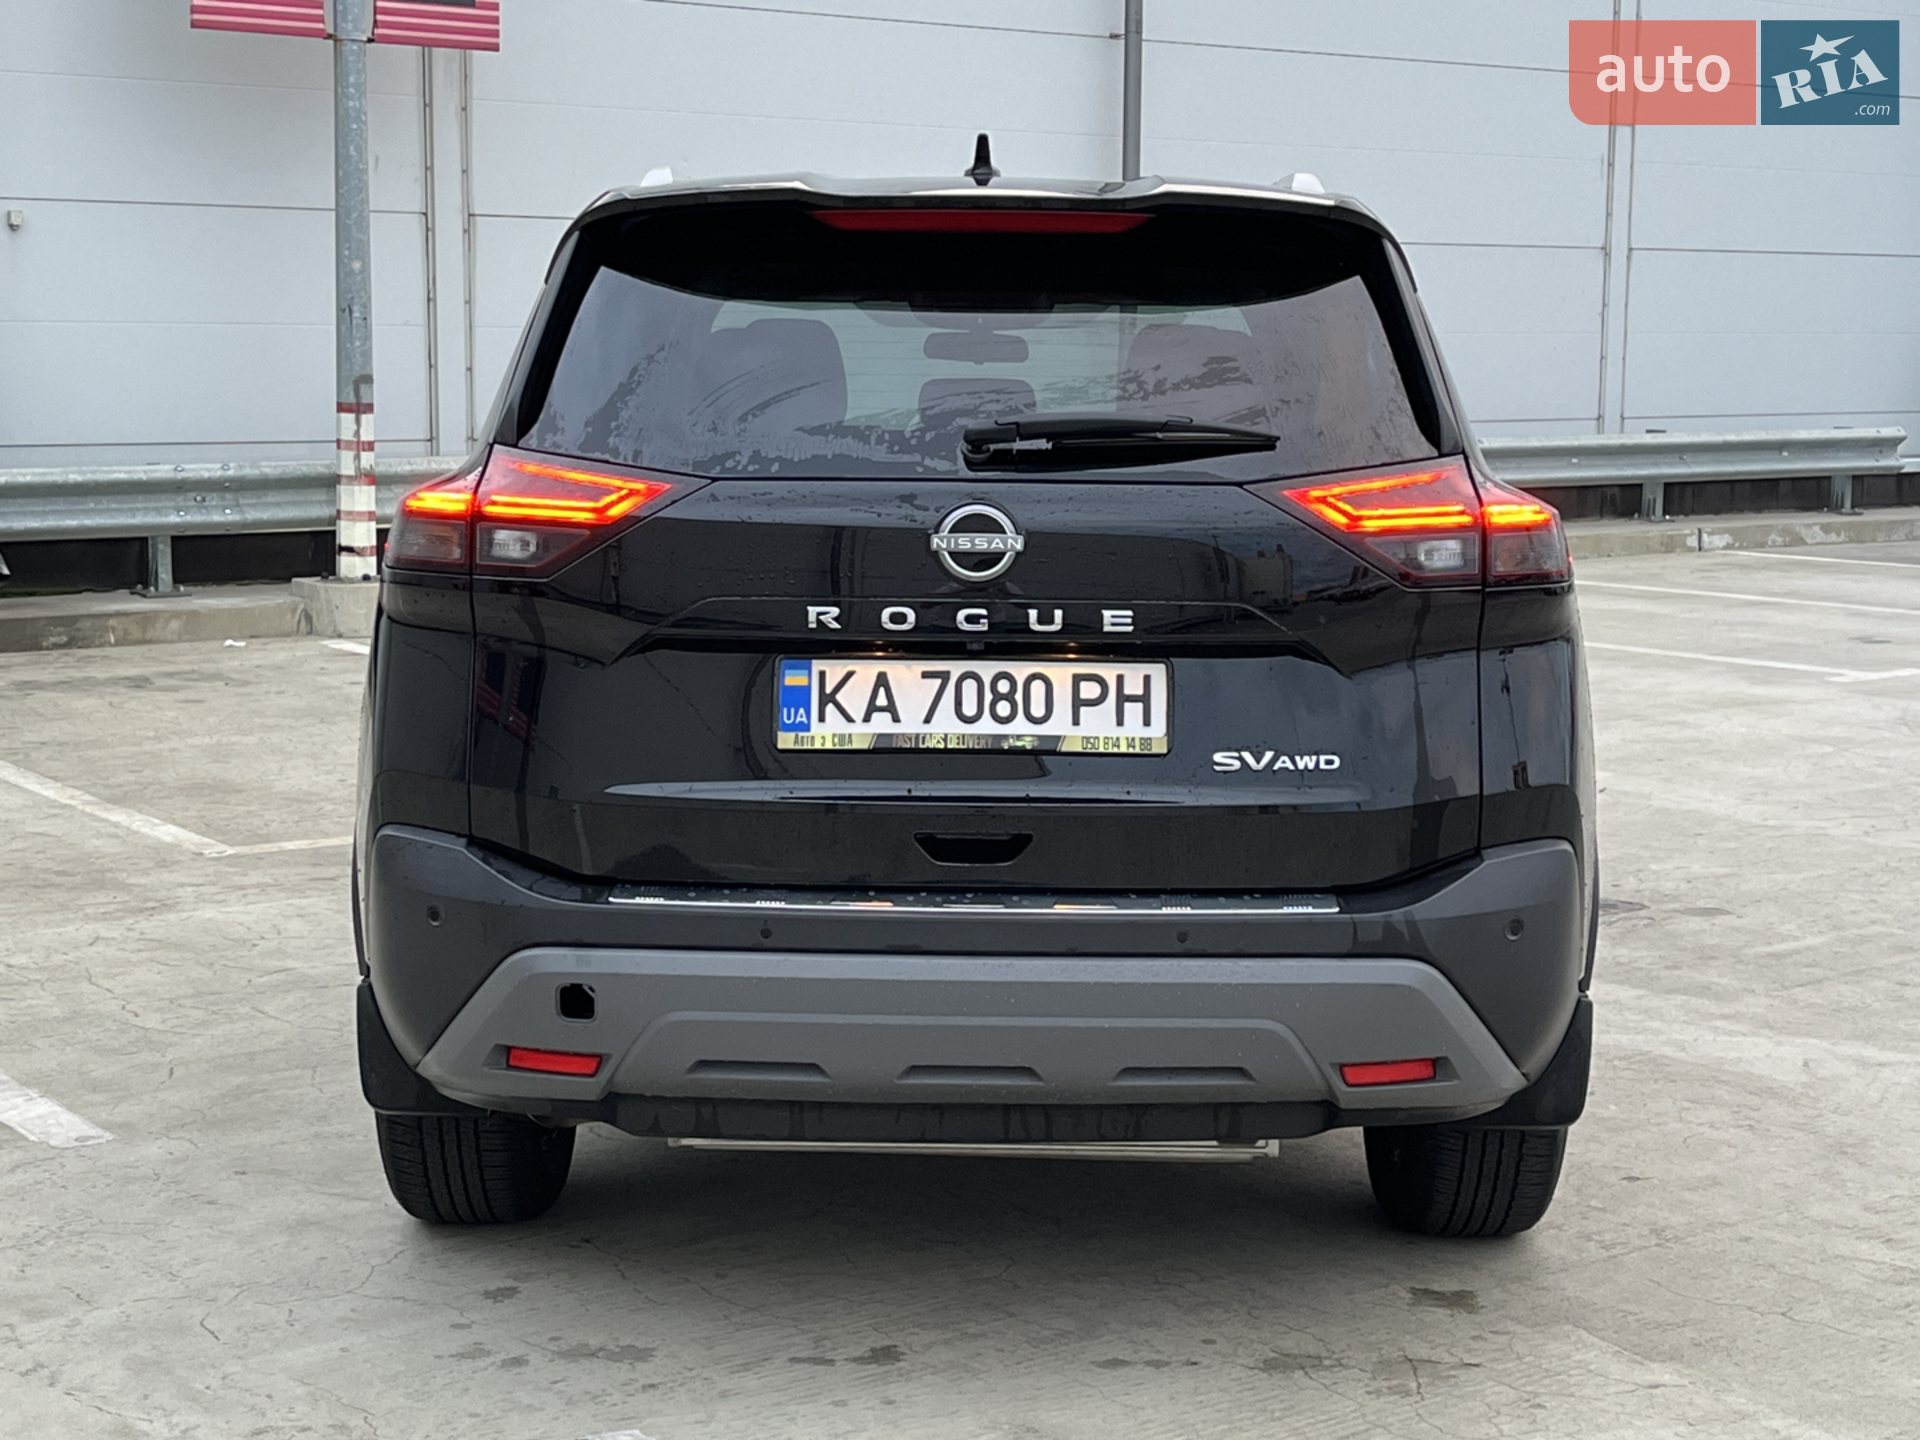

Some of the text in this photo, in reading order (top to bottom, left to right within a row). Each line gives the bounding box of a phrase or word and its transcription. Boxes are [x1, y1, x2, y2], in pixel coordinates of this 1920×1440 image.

[933, 537, 1022, 549] NISSAN
[807, 606, 1134, 632] ROGUE
[818, 670, 1151, 727] KA 7080 PH
[783, 708, 808, 723] UA
[832, 734, 853, 747] США
[893, 734, 993, 750] FAST CARS DELIVERY
[1081, 736, 1100, 750] 050
[1103, 736, 1121, 751] 814
[1125, 737, 1136, 751] 14
